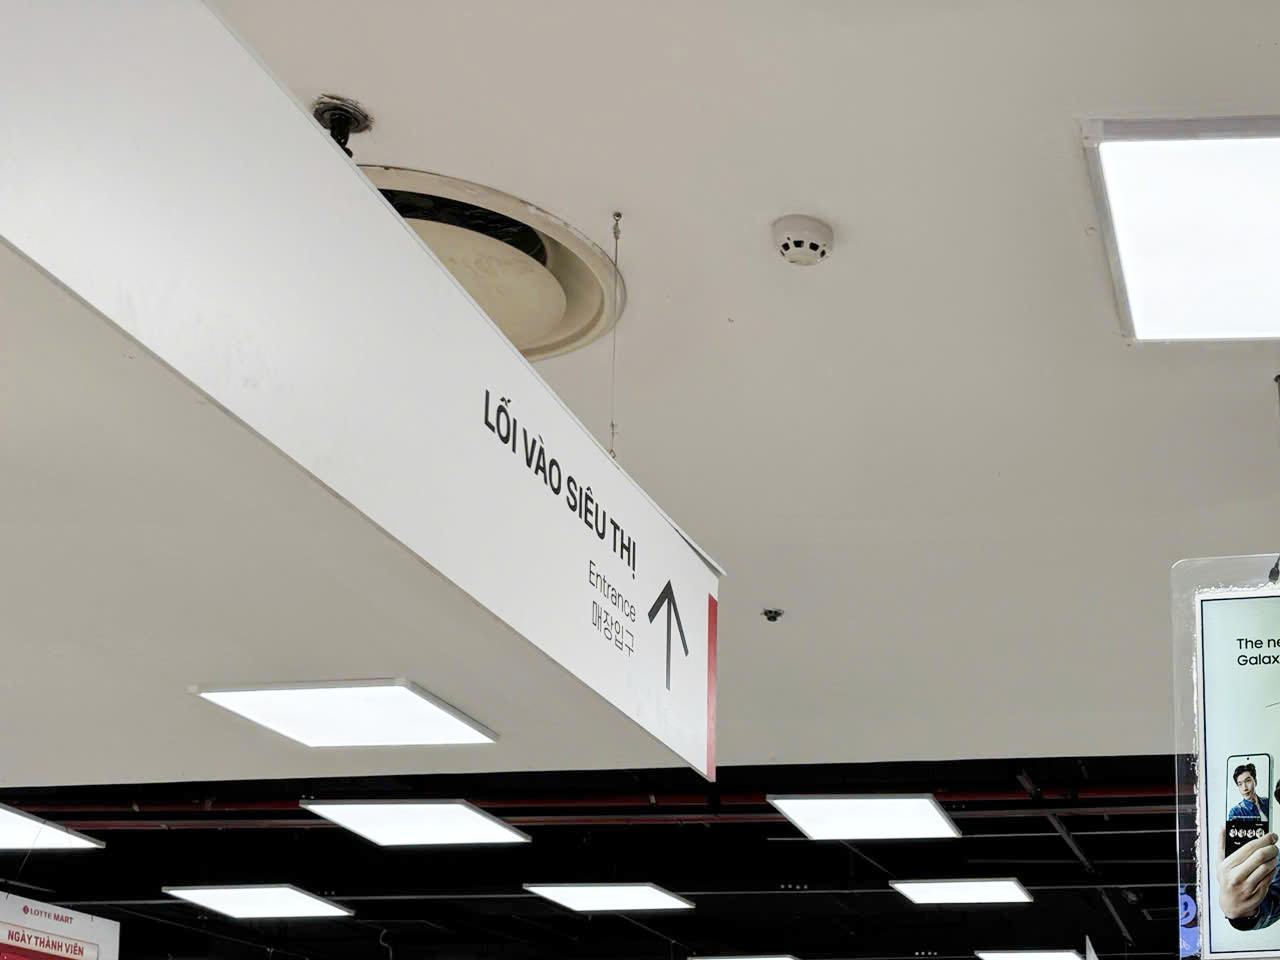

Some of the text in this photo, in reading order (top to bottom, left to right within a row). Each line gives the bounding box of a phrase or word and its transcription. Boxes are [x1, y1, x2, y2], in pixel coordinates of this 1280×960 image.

[484, 389, 637, 580] LỐI VÀO SIÊU THỊ
[589, 560, 636, 623] Entrance
[592, 600, 635, 658] 매장입구
[1236, 638, 1264, 649] The
[30, 908, 73, 925] LOTTE MART
[7, 929, 84, 956] NGÀY THÀNH VIÊN
